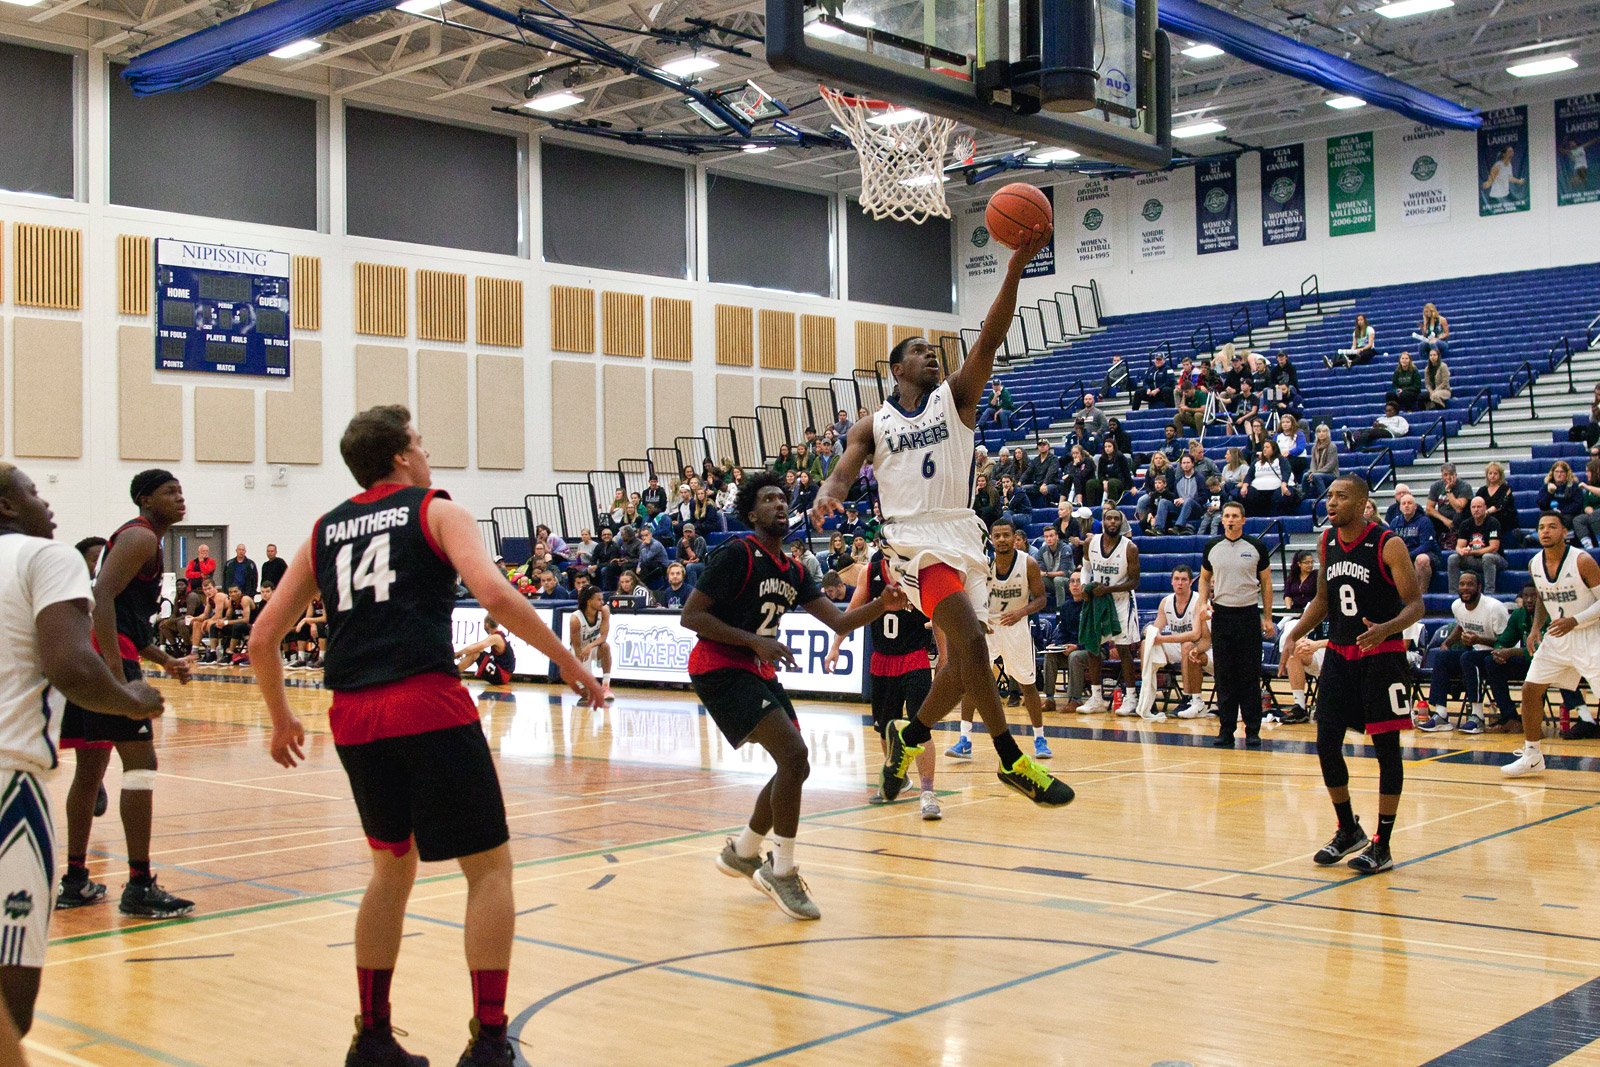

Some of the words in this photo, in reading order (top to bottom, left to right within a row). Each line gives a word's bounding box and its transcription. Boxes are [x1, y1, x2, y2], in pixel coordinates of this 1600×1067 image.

[1402, 129, 1446, 142] CHAMPIONS
[1355, 141, 1372, 149] WEST
[1334, 150, 1366, 161] DIVISION
[1266, 160, 1299, 171] CANADIAN
[1329, 156, 1371, 168] CHAMPIONS
[1136, 175, 1169, 186] CHAMPION
[1200, 171, 1232, 182] CANADIAN
[1076, 192, 1110, 202] CHAMPIONS
[1077, 187, 1103, 196] DIVISION
[1408, 188, 1443, 200] WOMEN'S
[1335, 200, 1368, 210] WOMEN'S
[1402, 196, 1447, 208] VOLLEYBALL
[1268, 209, 1299, 220] WOMEN'S
[1330, 205, 1373, 218] VOLLEYBALL
[1405, 204, 1447, 217] 2006-2007
[1202, 219, 1232, 230] WOMEN'S
[1263, 215, 1304, 228] VOLLEYBALL
[1332, 214, 1372, 227] 2006-2007
[1141, 229, 1166, 238] NORDIC
[1204, 226, 1230, 236] SOCCER
[1080, 238, 1107, 247] WOMEN'S
[1143, 236, 1165, 244] SKIING
[1076, 244, 1111, 254] VOLLEYBALL
[182, 245, 268, 267] NIPISSING
[969, 254, 994, 263] WOMEN'S
[167, 287, 191, 299] HOME
[217, 302, 234, 310] PERIOD
[259, 297, 282, 309] GUEST
[160, 330, 169, 338] TM
[170, 331, 187, 339] FOULS
[206, 334, 227, 342] PLAYER
[231, 336, 248, 344] FOULS
[264, 338, 272, 346] TM
[273, 339, 289, 347] FOULS
[163, 360, 184, 369] POINTS
[216, 364, 236, 372] MATCH
[267, 367, 286, 375] POINTS
[885, 419, 950, 455] LAKERS
[921, 450, 937, 480] 6
[325, 506, 410, 547] PANTHERS
[335, 532, 397, 613] 14
[1092, 562, 1120, 575] LAKERS
[1326, 560, 1370, 584] CANADORE
[1100, 575, 1111, 587] 13
[989, 587, 1022, 600] AKERS
[1540, 589, 1578, 603] LAKERS
[1000, 601, 1009, 612] 7
[1339, 584, 1359, 617] 8
[756, 601, 786, 637] 2
[883, 612, 899, 640] 0
[621, 642, 690, 667] LAKERS
[776, 629, 855, 675] ERS
[1388, 682, 1411, 716] C
